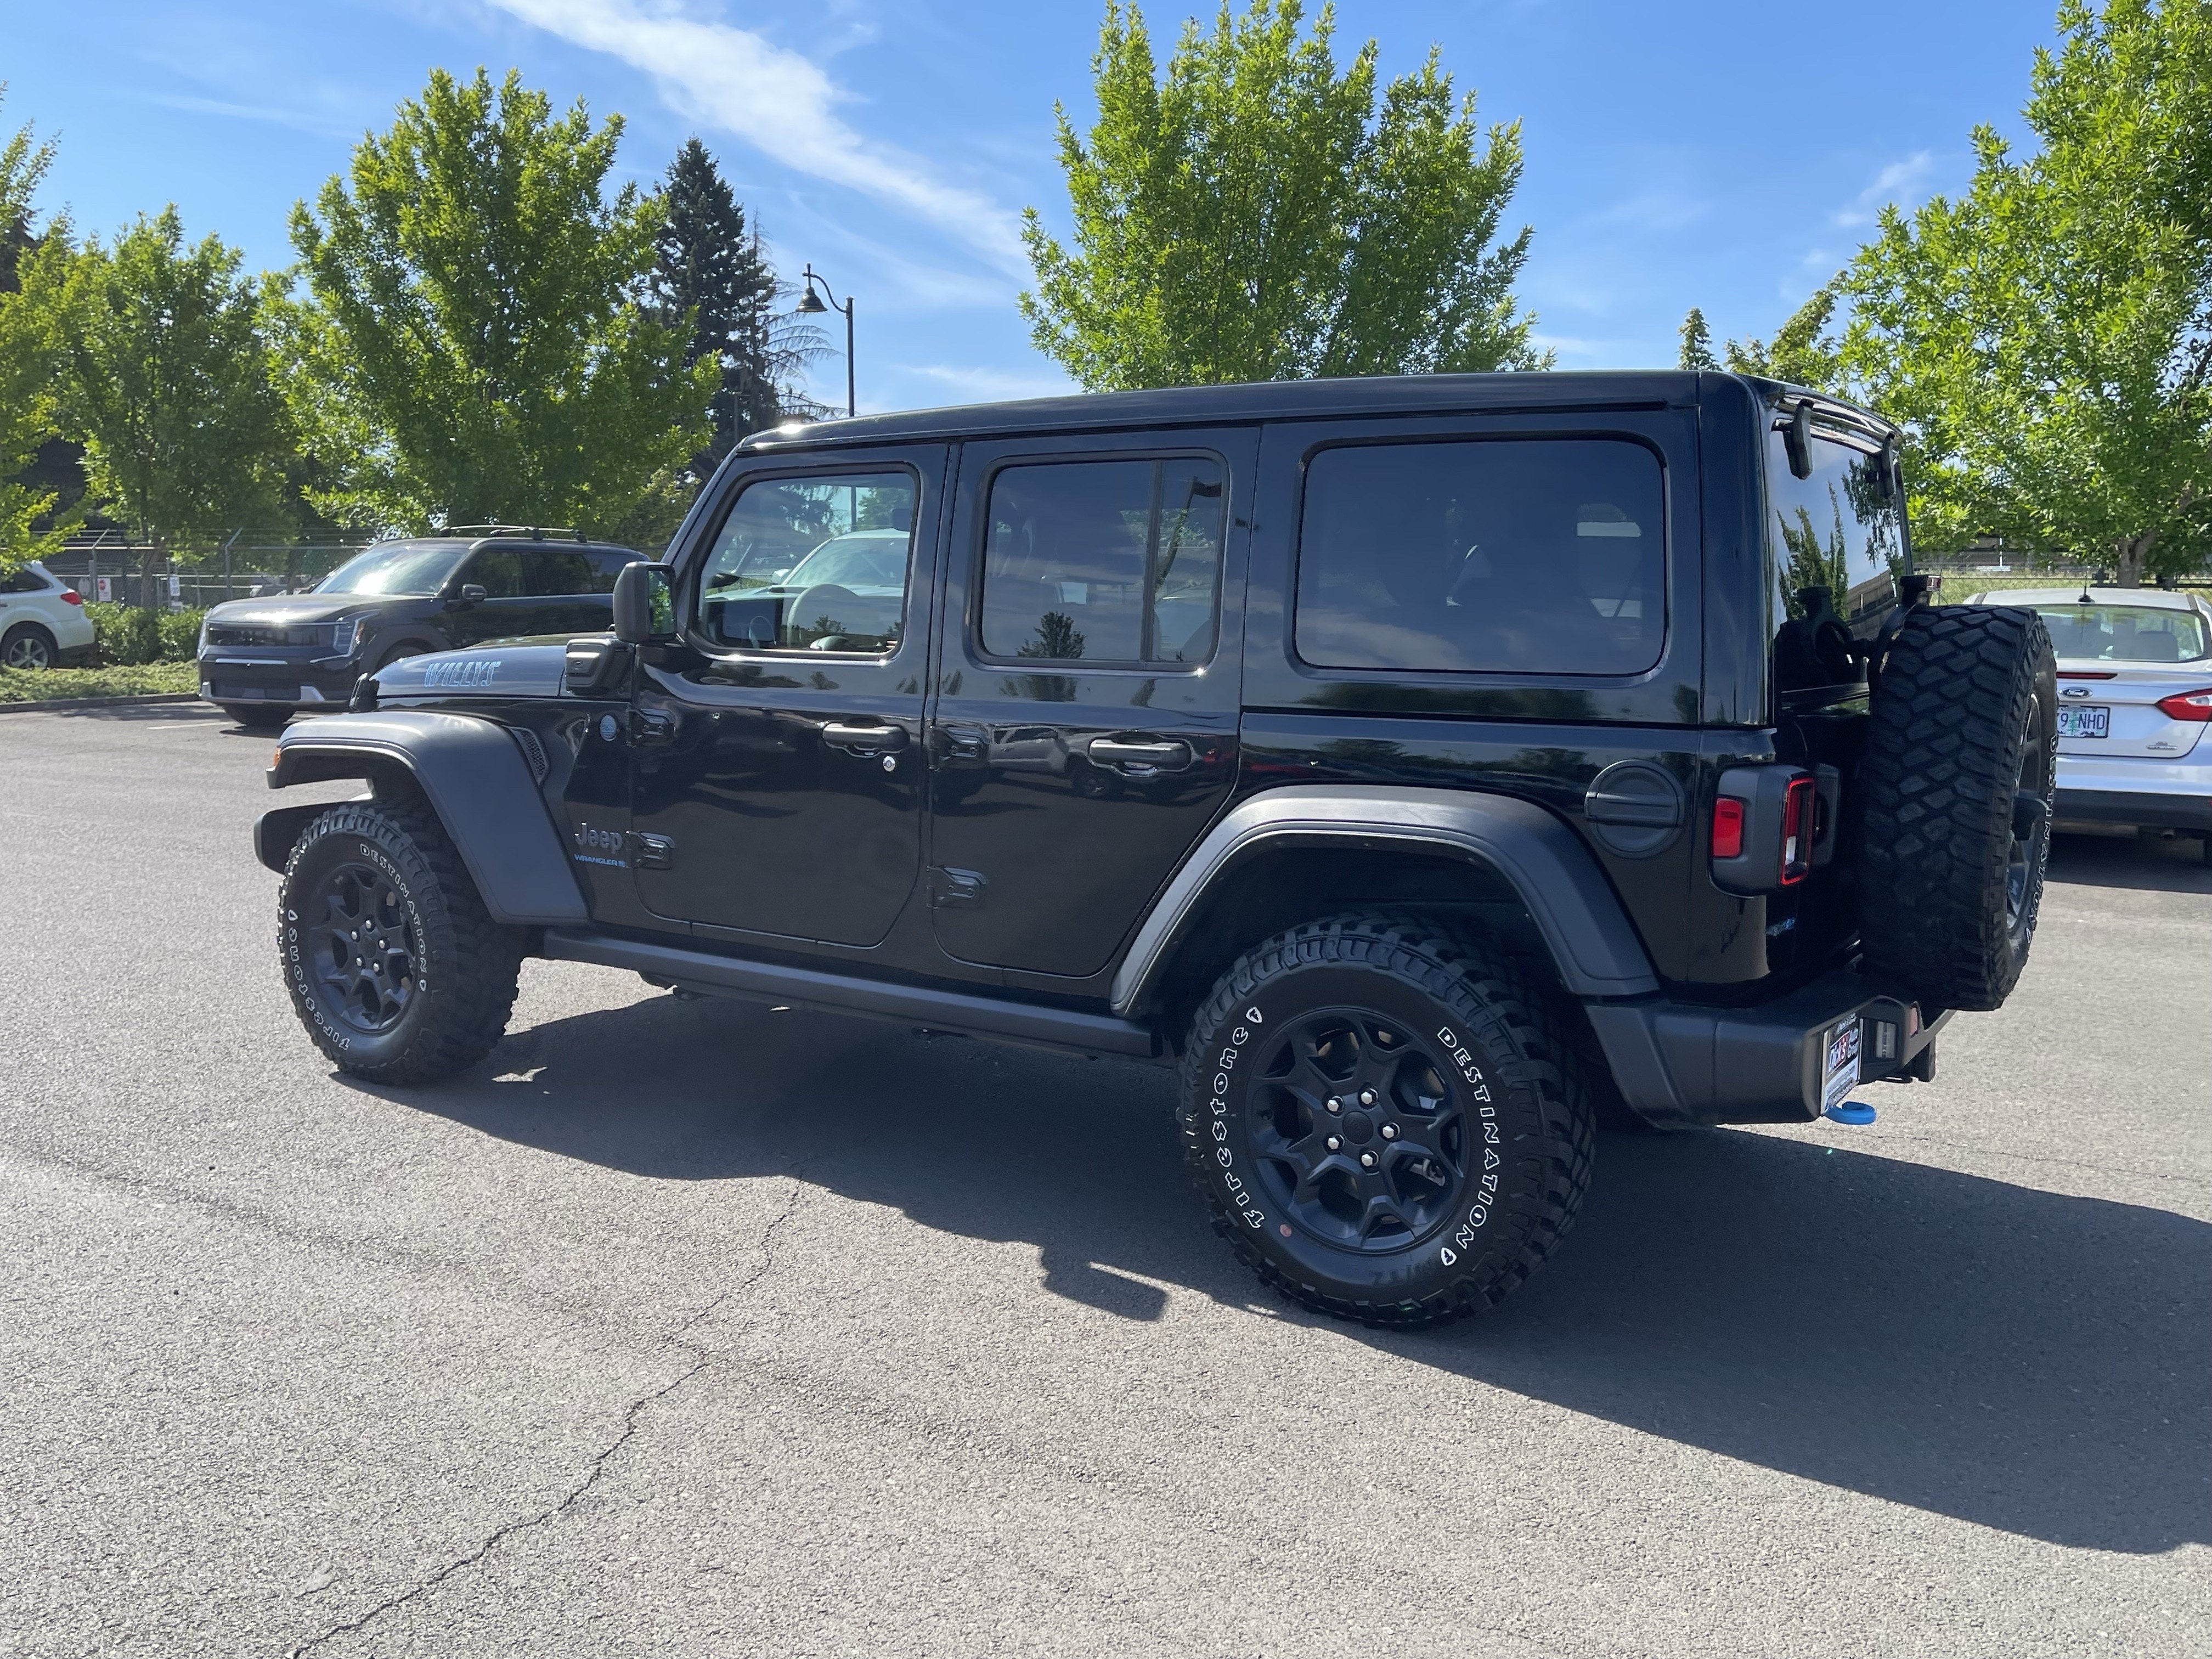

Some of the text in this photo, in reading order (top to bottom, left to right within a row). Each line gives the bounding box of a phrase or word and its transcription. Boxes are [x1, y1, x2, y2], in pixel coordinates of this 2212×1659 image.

[424, 661, 502, 687] WILLYS
[2078, 714, 2105, 730] NHD
[574, 822, 622, 855] Jeep
[574, 854, 617, 866] WRANGLER
[359, 843, 428, 973] DESTINATION
[1209, 1026, 1265, 1228] Firestone
[1437, 1026, 1500, 1249] DESTINATION
